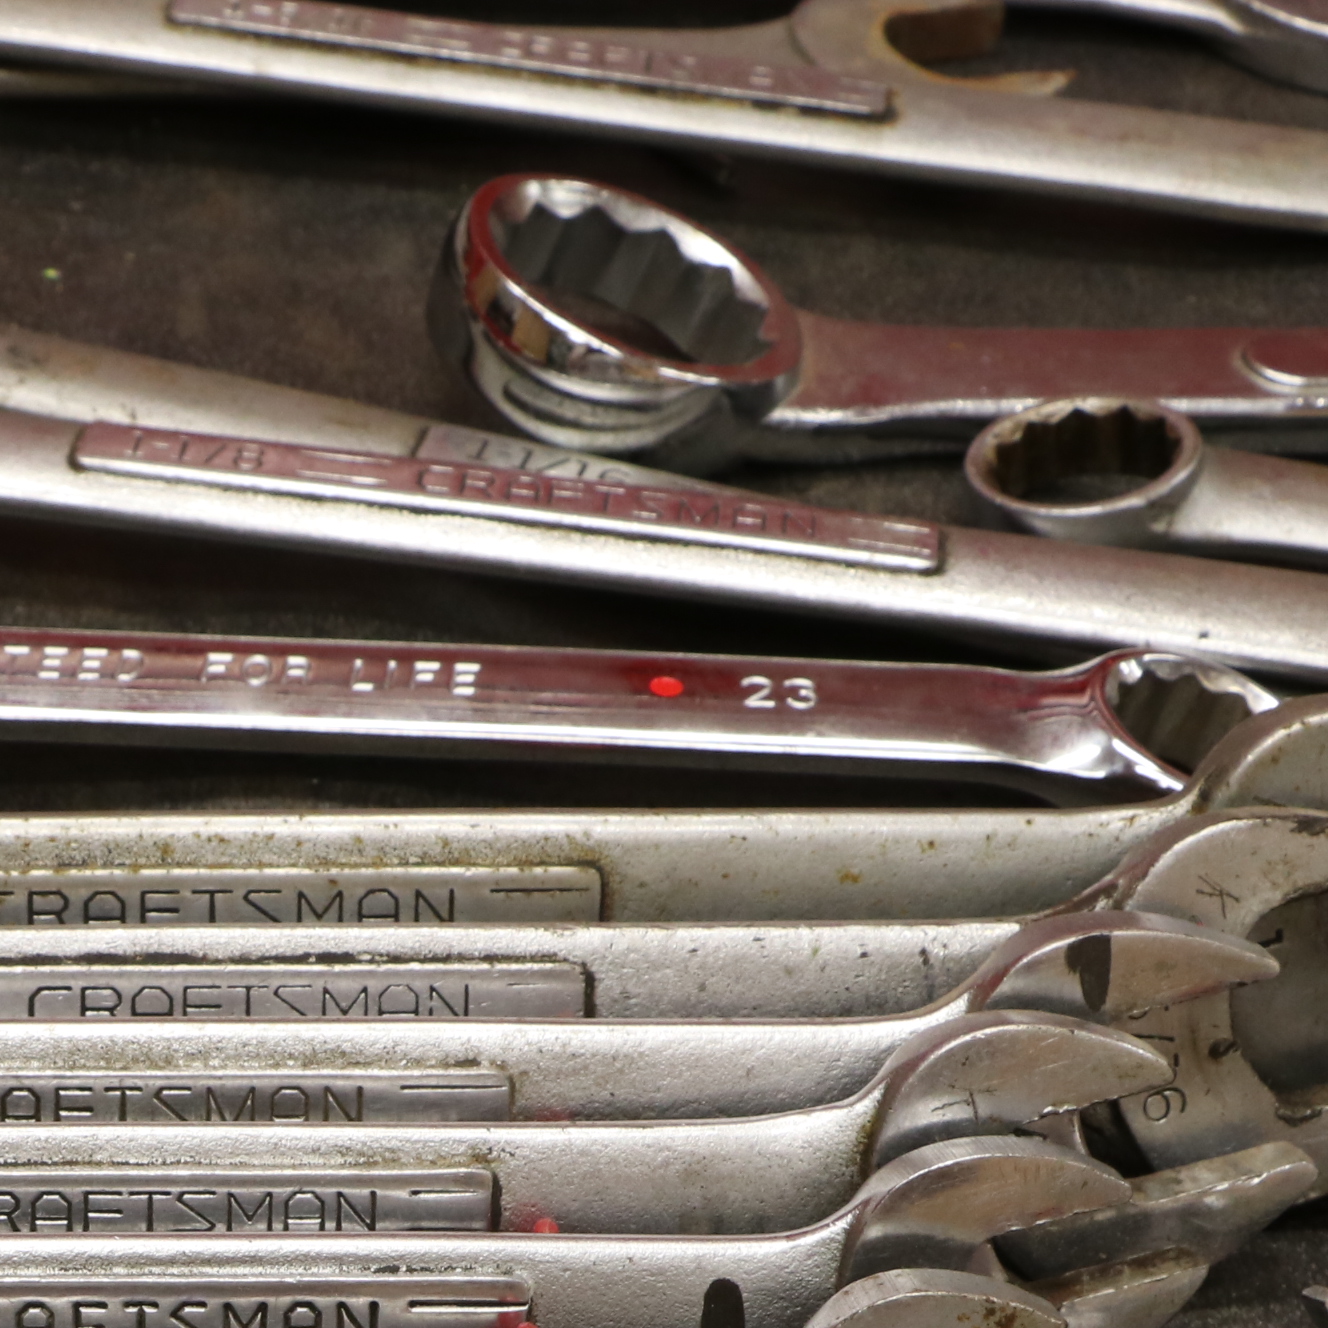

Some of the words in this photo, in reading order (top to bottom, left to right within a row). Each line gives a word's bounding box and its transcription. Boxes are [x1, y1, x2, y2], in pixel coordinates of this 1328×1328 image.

[417, 465, 817, 537] CRAFTSMAN
[201, 652, 310, 688] FOR
[350, 656, 482, 697] LIFE
[740, 675, 818, 710] 23
[28, 984, 470, 1018] CRAFTSMAN
